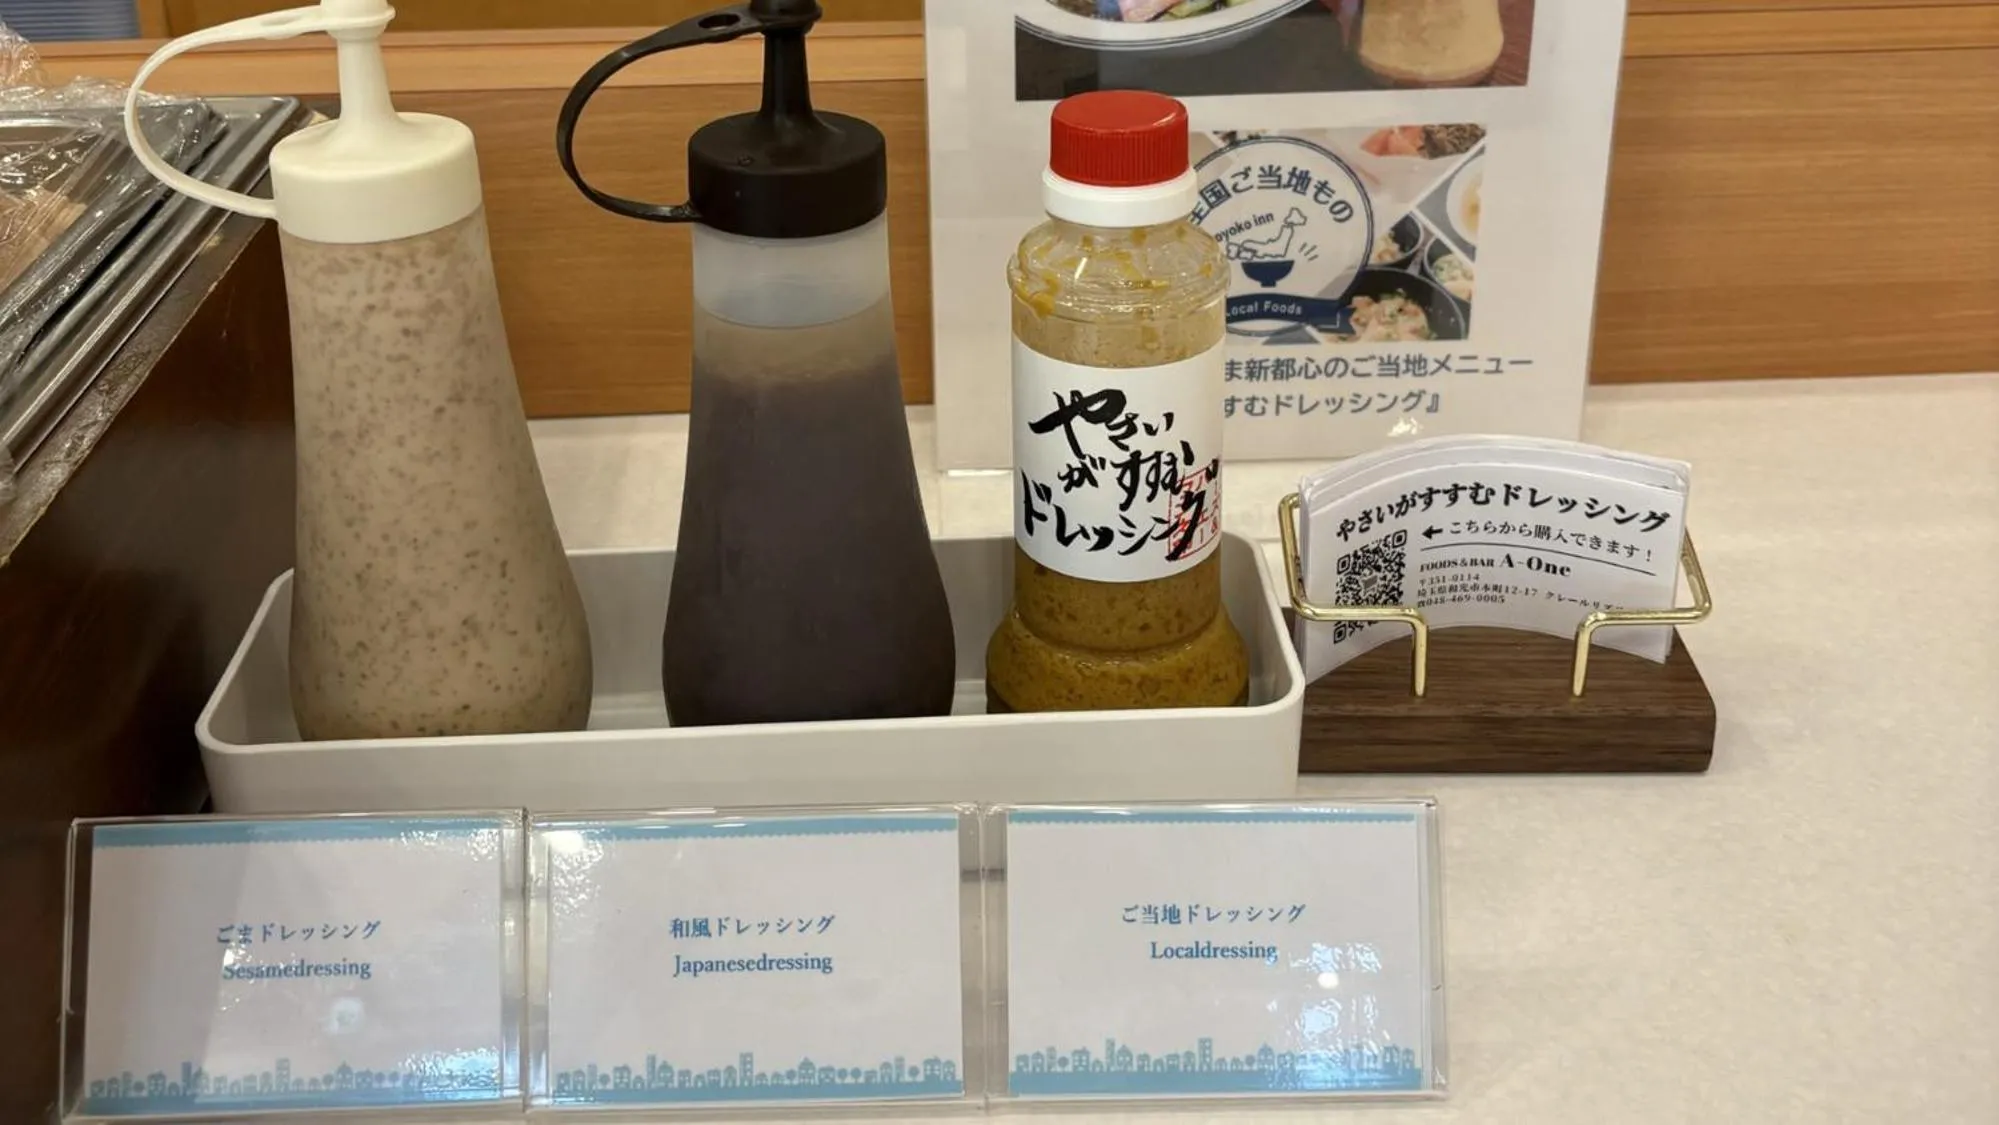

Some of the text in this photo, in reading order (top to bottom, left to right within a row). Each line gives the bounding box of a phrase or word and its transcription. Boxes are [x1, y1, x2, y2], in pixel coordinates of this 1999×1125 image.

[1215, 212, 1275, 244] oyoko inn
[1228, 300, 1303, 317] ocal Foods
[1028, 388, 1174, 460] やさい
[1057, 440, 1195, 512] がすすむ
[1020, 458, 1220, 562] ドレッシング
[1335, 481, 1671, 543] やさいがすすむドレッシング
[1500, 552, 1572, 577] A-One
[1122, 903, 1307, 925] ご当地ドレッシング
[216, 920, 382, 944] ごまドレッシング
[670, 915, 836, 939] 和風ドレッシング
[1150, 941, 1278, 963] Localdressing
[223, 957, 372, 980] Sesamedressing
[672, 952, 834, 978] Japanesedressing
